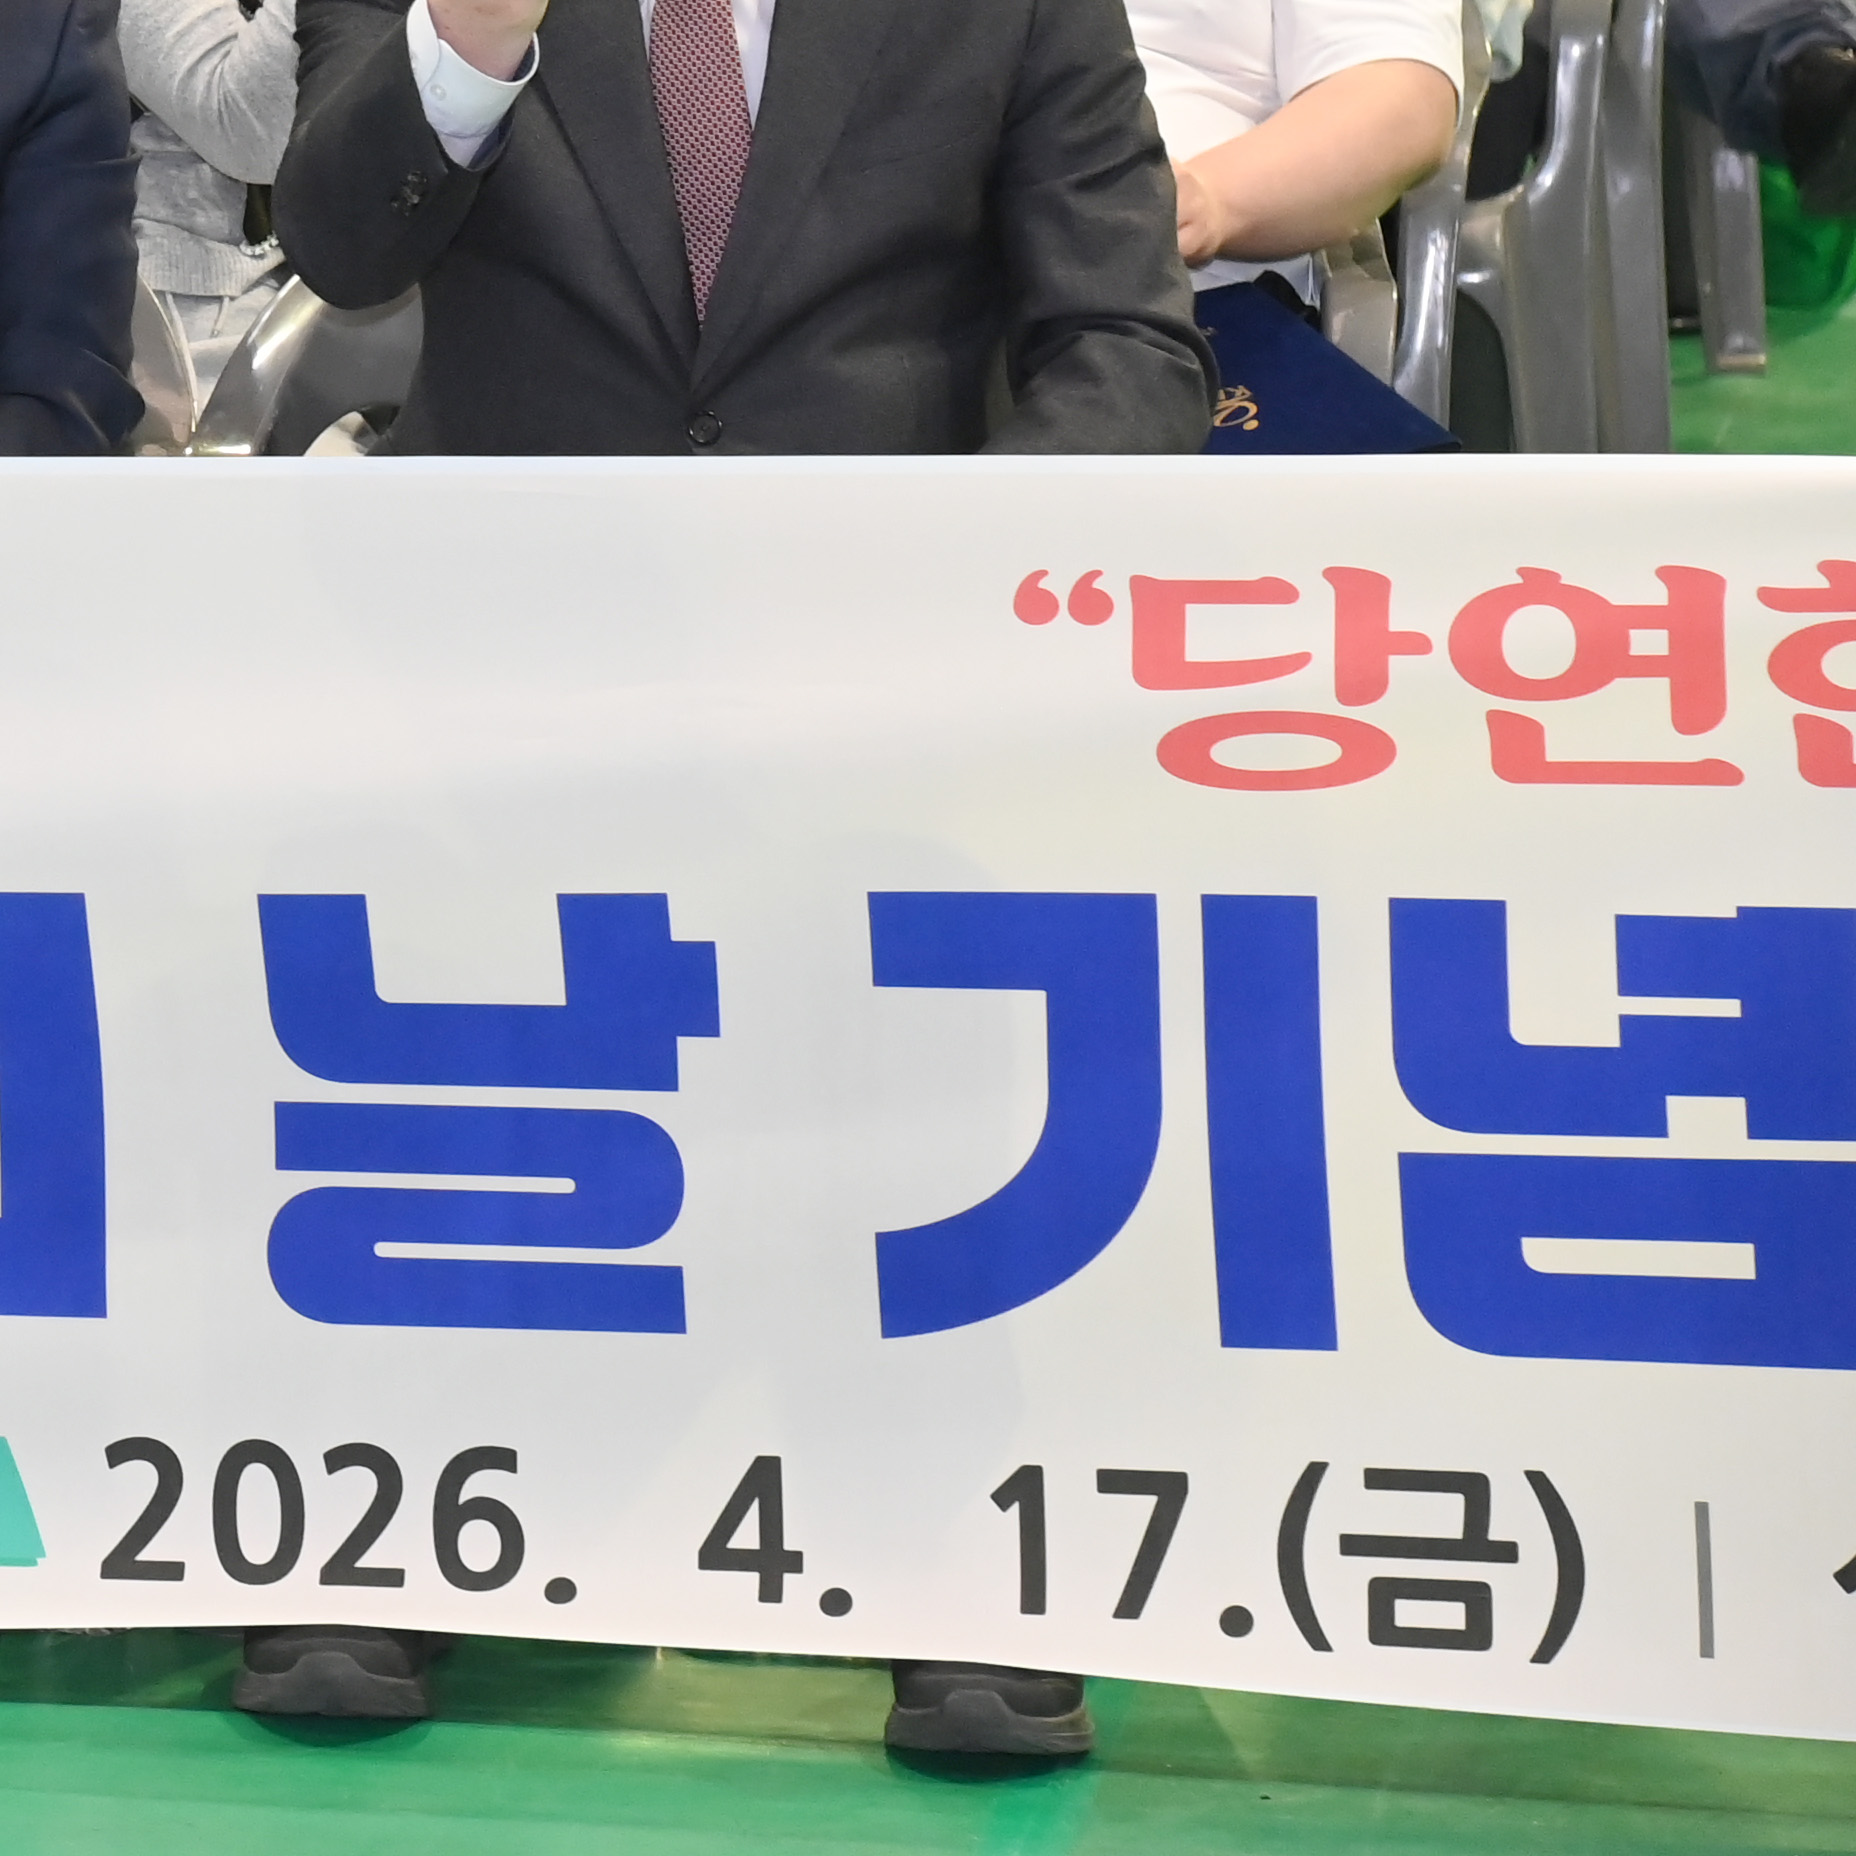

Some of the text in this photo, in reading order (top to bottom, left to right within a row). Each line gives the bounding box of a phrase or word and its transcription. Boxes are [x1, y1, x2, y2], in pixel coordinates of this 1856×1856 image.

[258, 892, 721, 1335] 날
[868, 891, 1856, 1370] 기념
[100, 1436, 577, 1605] 2026.
[698, 1455, 854, 1617] 4.
[990, 1460, 1586, 1664] 17.(금)
